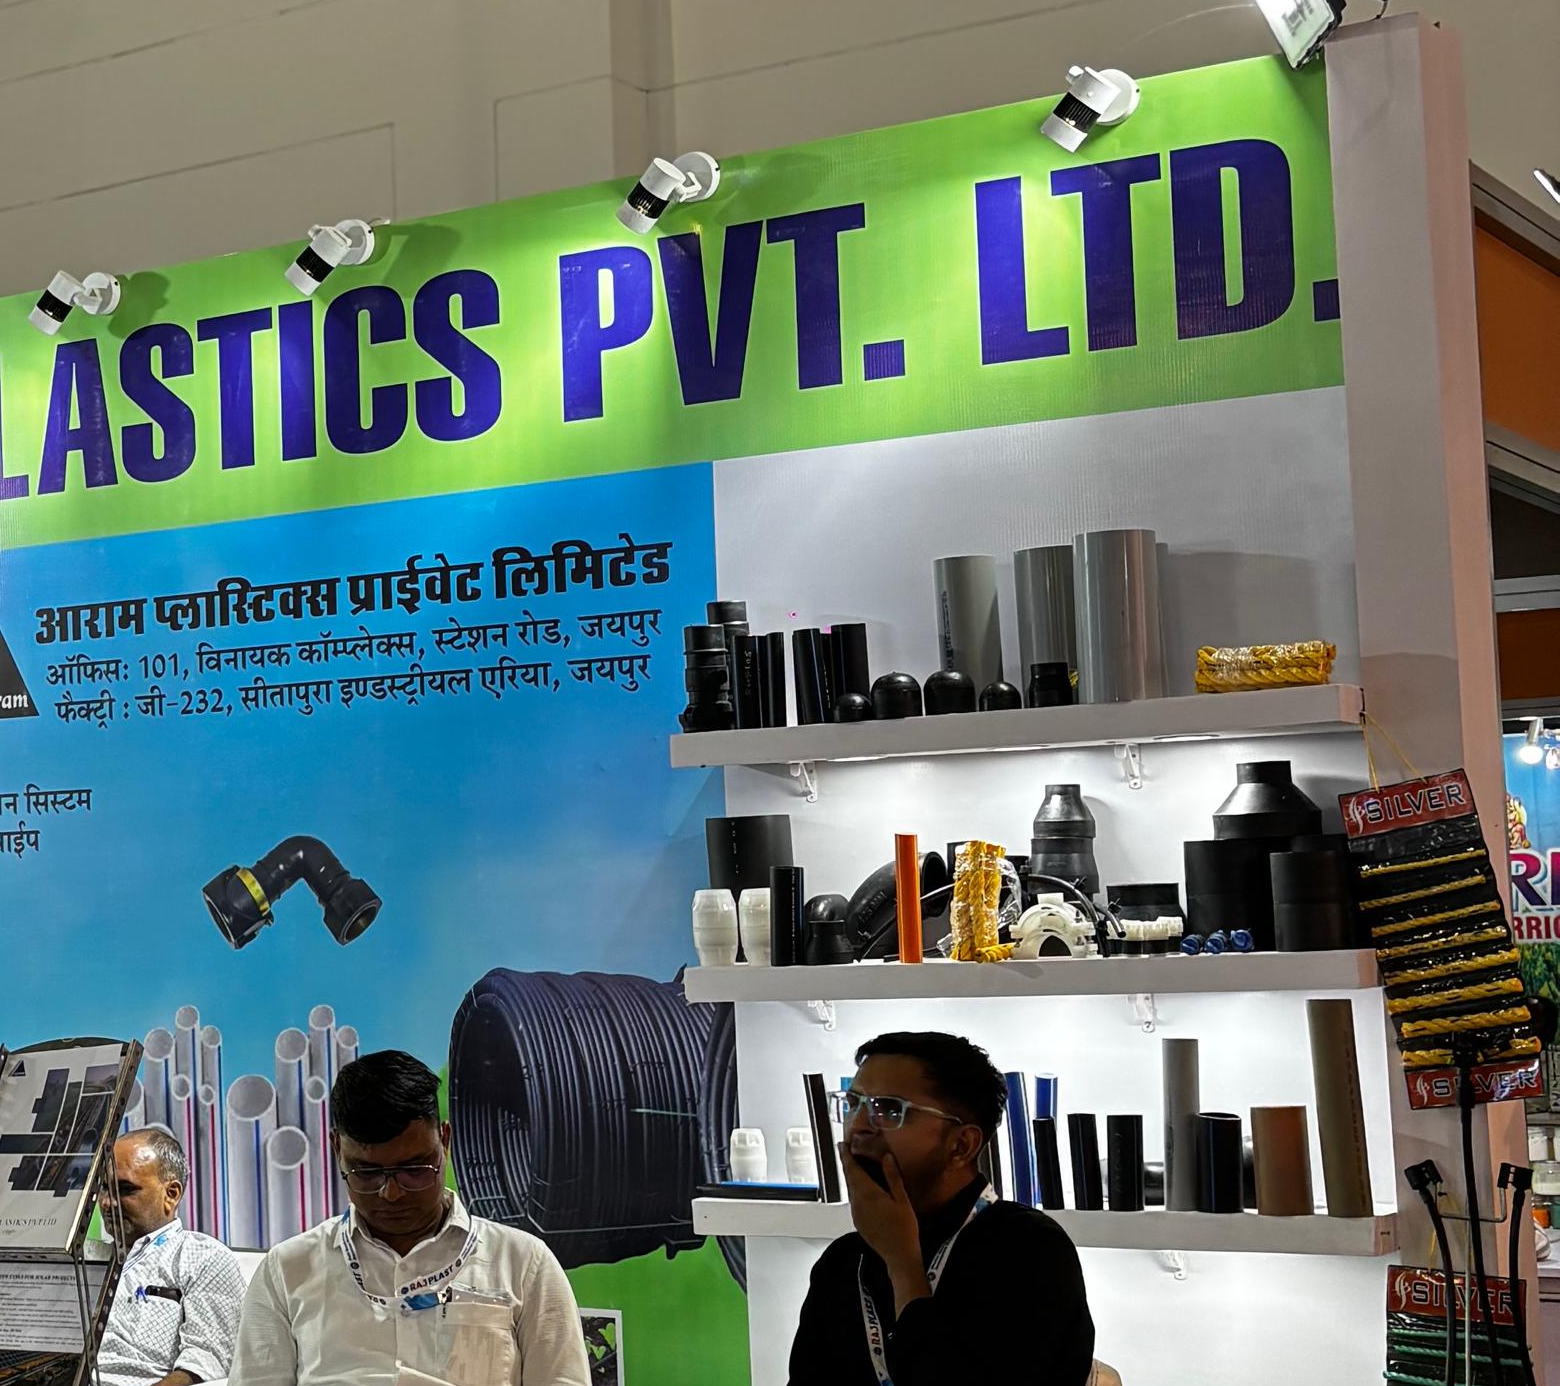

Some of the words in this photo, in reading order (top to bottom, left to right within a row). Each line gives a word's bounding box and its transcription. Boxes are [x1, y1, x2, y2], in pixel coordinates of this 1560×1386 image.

[559, 204, 907, 423] PVT.
[973, 137, 1343, 367] LTD.
[35, 597, 147, 645] आराम
[154, 576, 340, 631] प्लास्टिक्स
[347, 553, 485, 616] प्राईवेट
[491, 532, 674, 599] लिमिटेड
[45, 653, 129, 687] ऑफिस:
[139, 652, 190, 682] 101,
[196, 641, 292, 674] विनायक
[296, 626, 425, 665] कॉम्प्लेक्स,
[431, 616, 510, 653] स्टेशन
[514, 609, 571, 649] रोड,
[577, 609, 664, 646] जयपुर
[54, 689, 116, 729] फैक्ट्री
[134, 684, 234, 718] जी-232,
[238, 677, 333, 715] सीतापुरा
[479, 655, 560, 701] एरिया,
[568, 654, 653, 691] जयपुर
[24, 782, 93, 815] सिस्टम
[1366, 782, 1466, 823] SILVER
[1432, 1070, 1537, 1096] SVER
